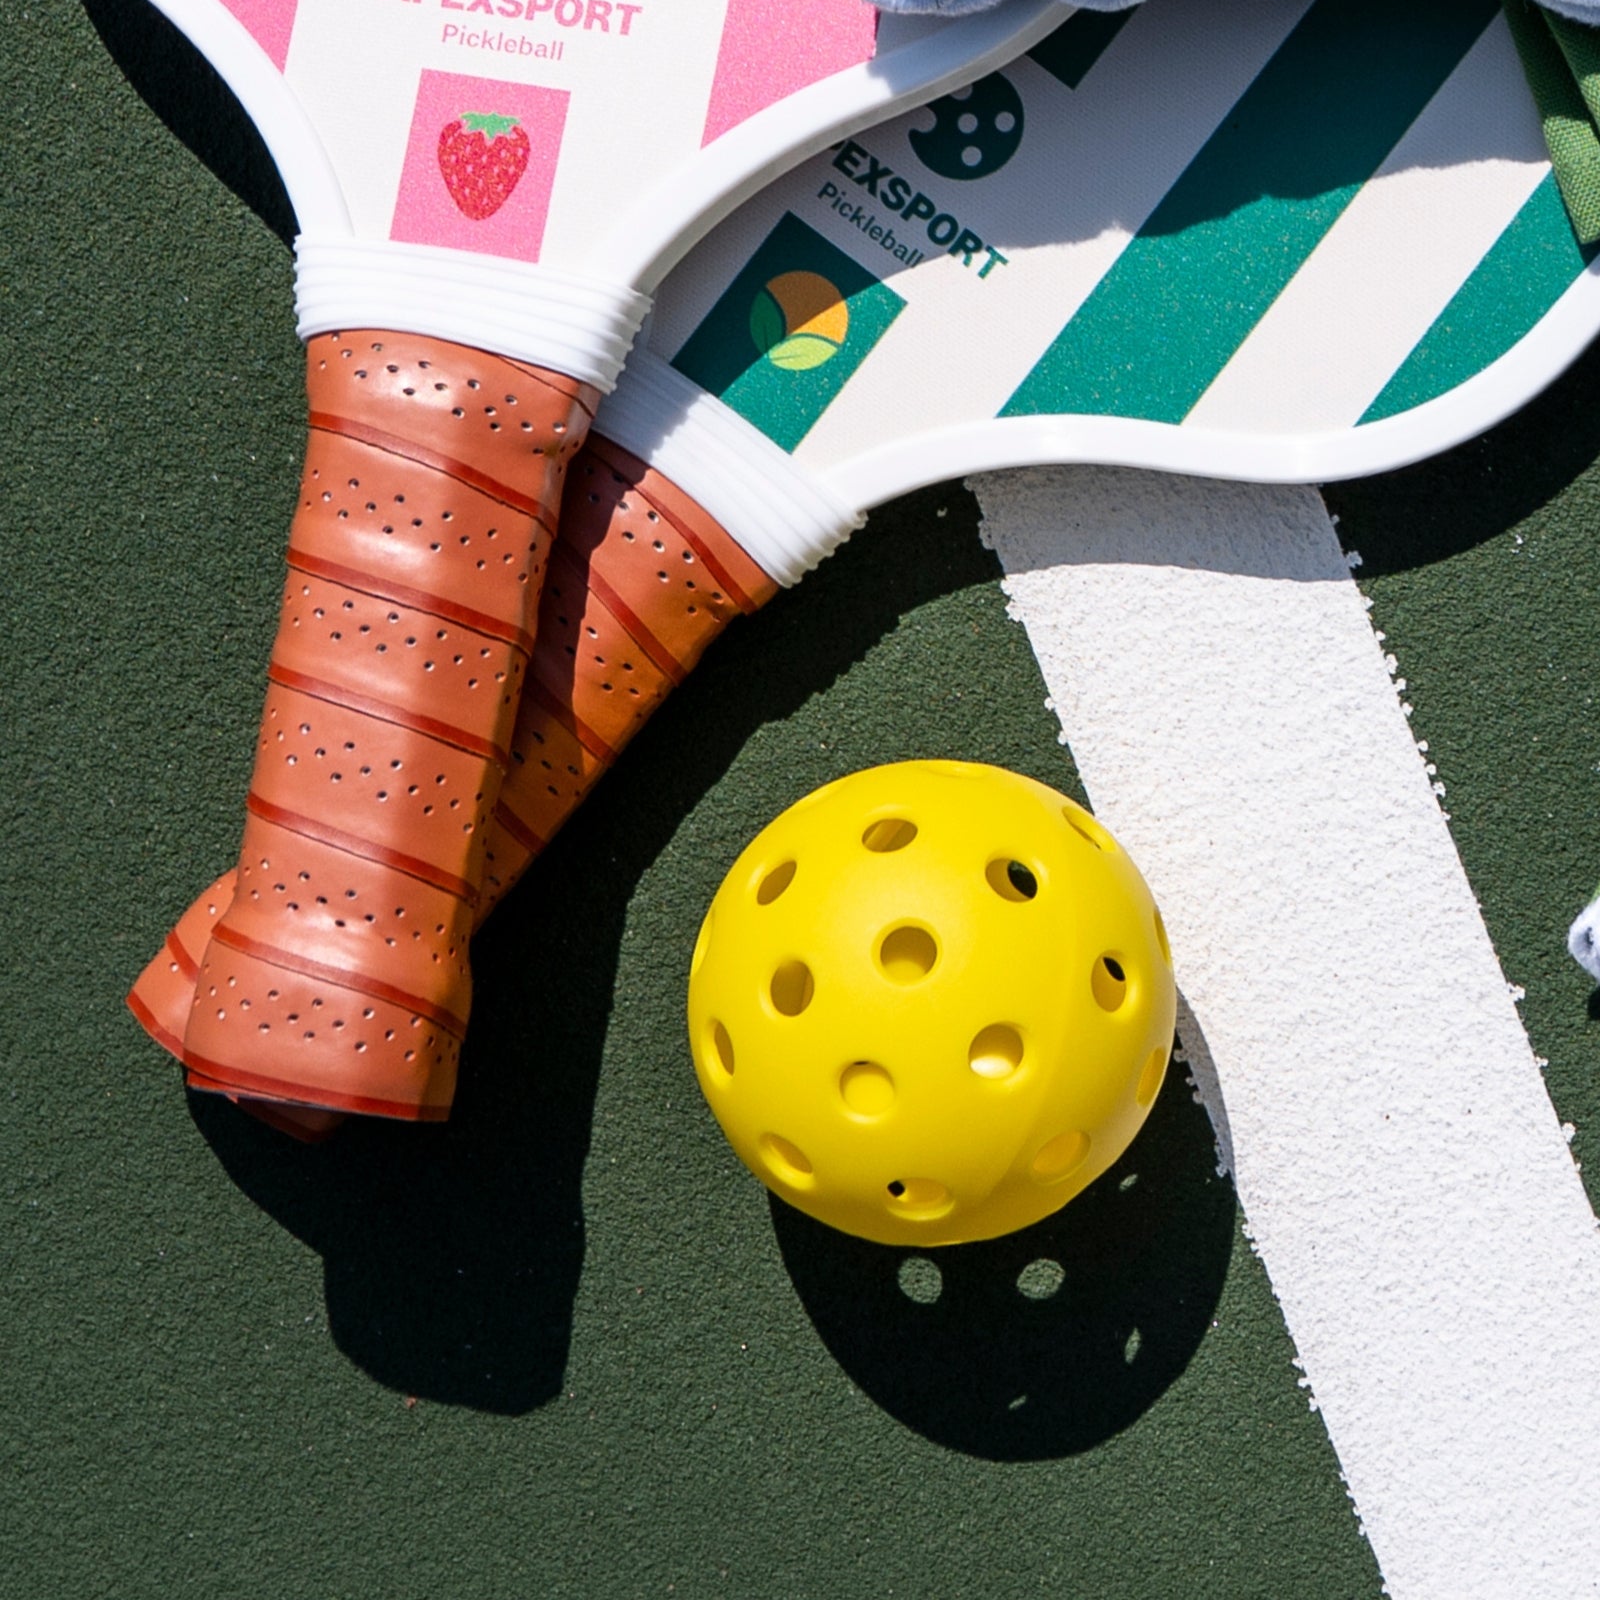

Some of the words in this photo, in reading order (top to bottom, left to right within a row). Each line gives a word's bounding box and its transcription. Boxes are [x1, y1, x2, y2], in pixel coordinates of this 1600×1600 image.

[441, 23, 565, 62] Pickleball
[816, 181, 925, 269] Pickleball
[829, 139, 1010, 280] EXSPORT
